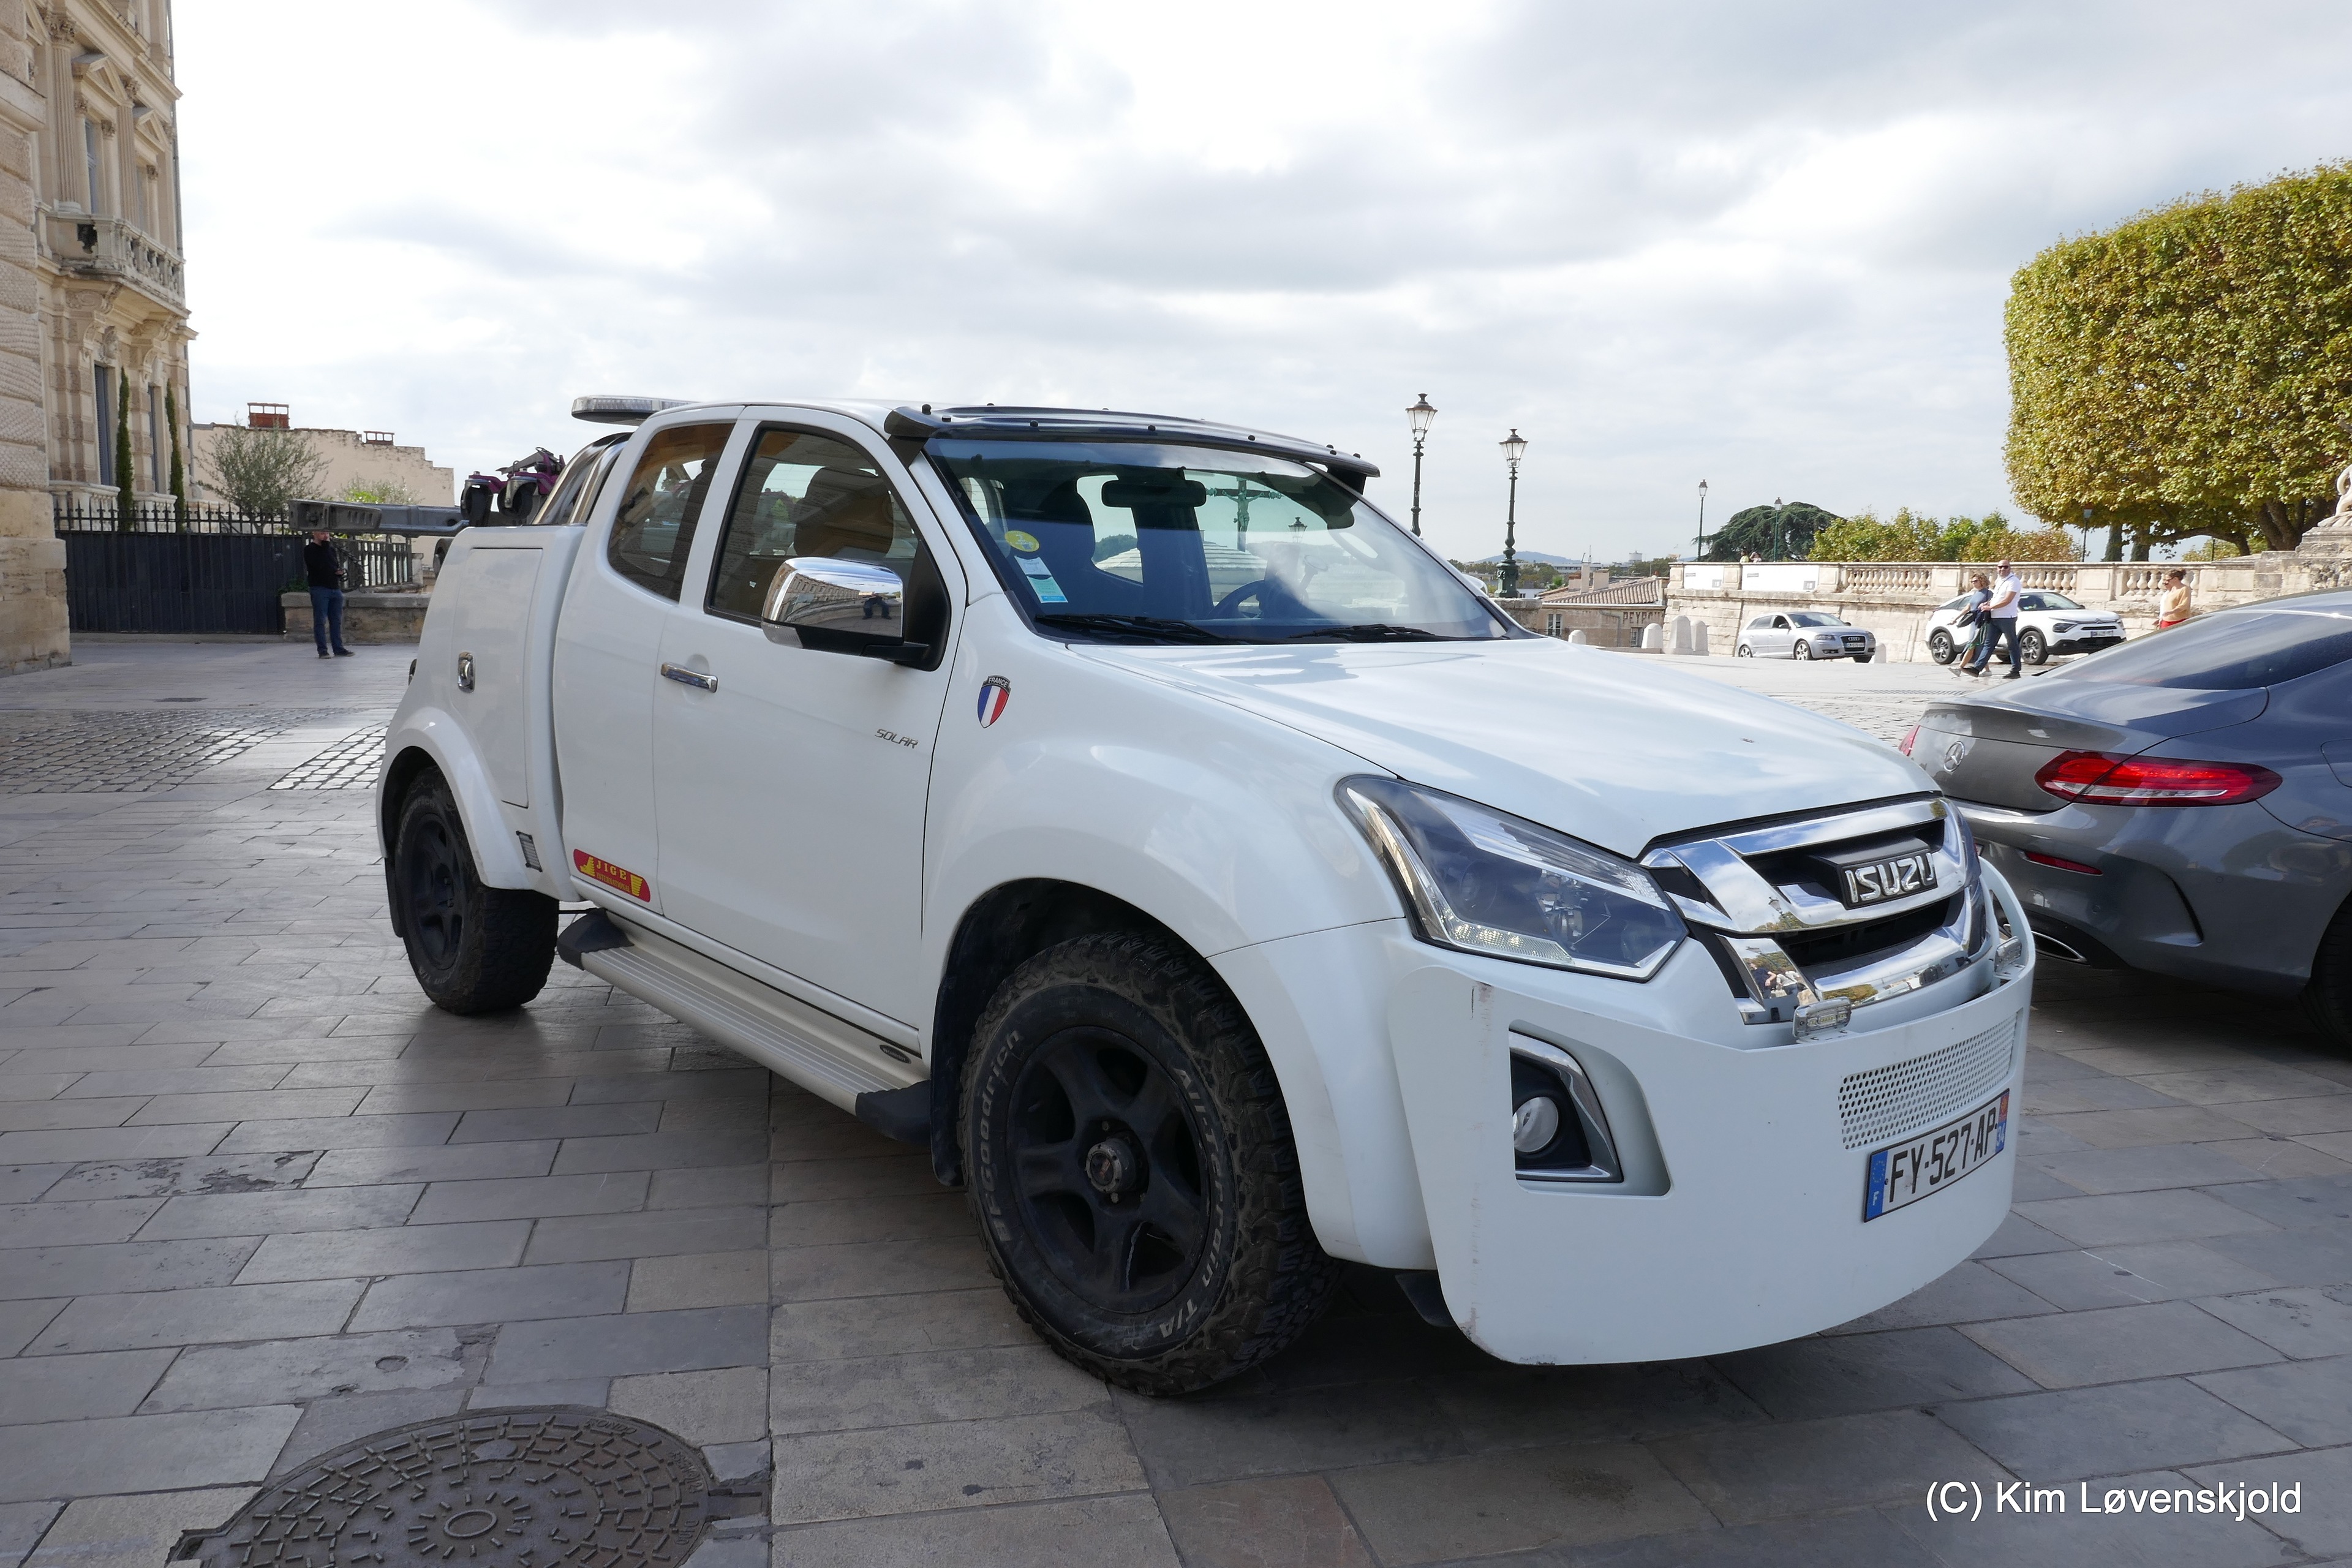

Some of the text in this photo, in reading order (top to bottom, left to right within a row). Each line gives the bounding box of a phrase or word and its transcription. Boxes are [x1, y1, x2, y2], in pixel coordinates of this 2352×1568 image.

[1623, 612, 1660, 624] PEYRO
[988, 677, 1008, 687] FRANCE
[875, 729, 918, 748] SOLAR
[597, 860, 627, 880] JIGE
[1845, 853, 1934, 903] ISUZU
[980, 1029, 1023, 1242] BFGoodrich
[1890, 1107, 1997, 1203] FY-527-AP
[1159, 1068, 1224, 1339] All-Terrain T/A
[1872, 1190, 1880, 1206] F
[585, 1418, 638, 1434] RONDO
